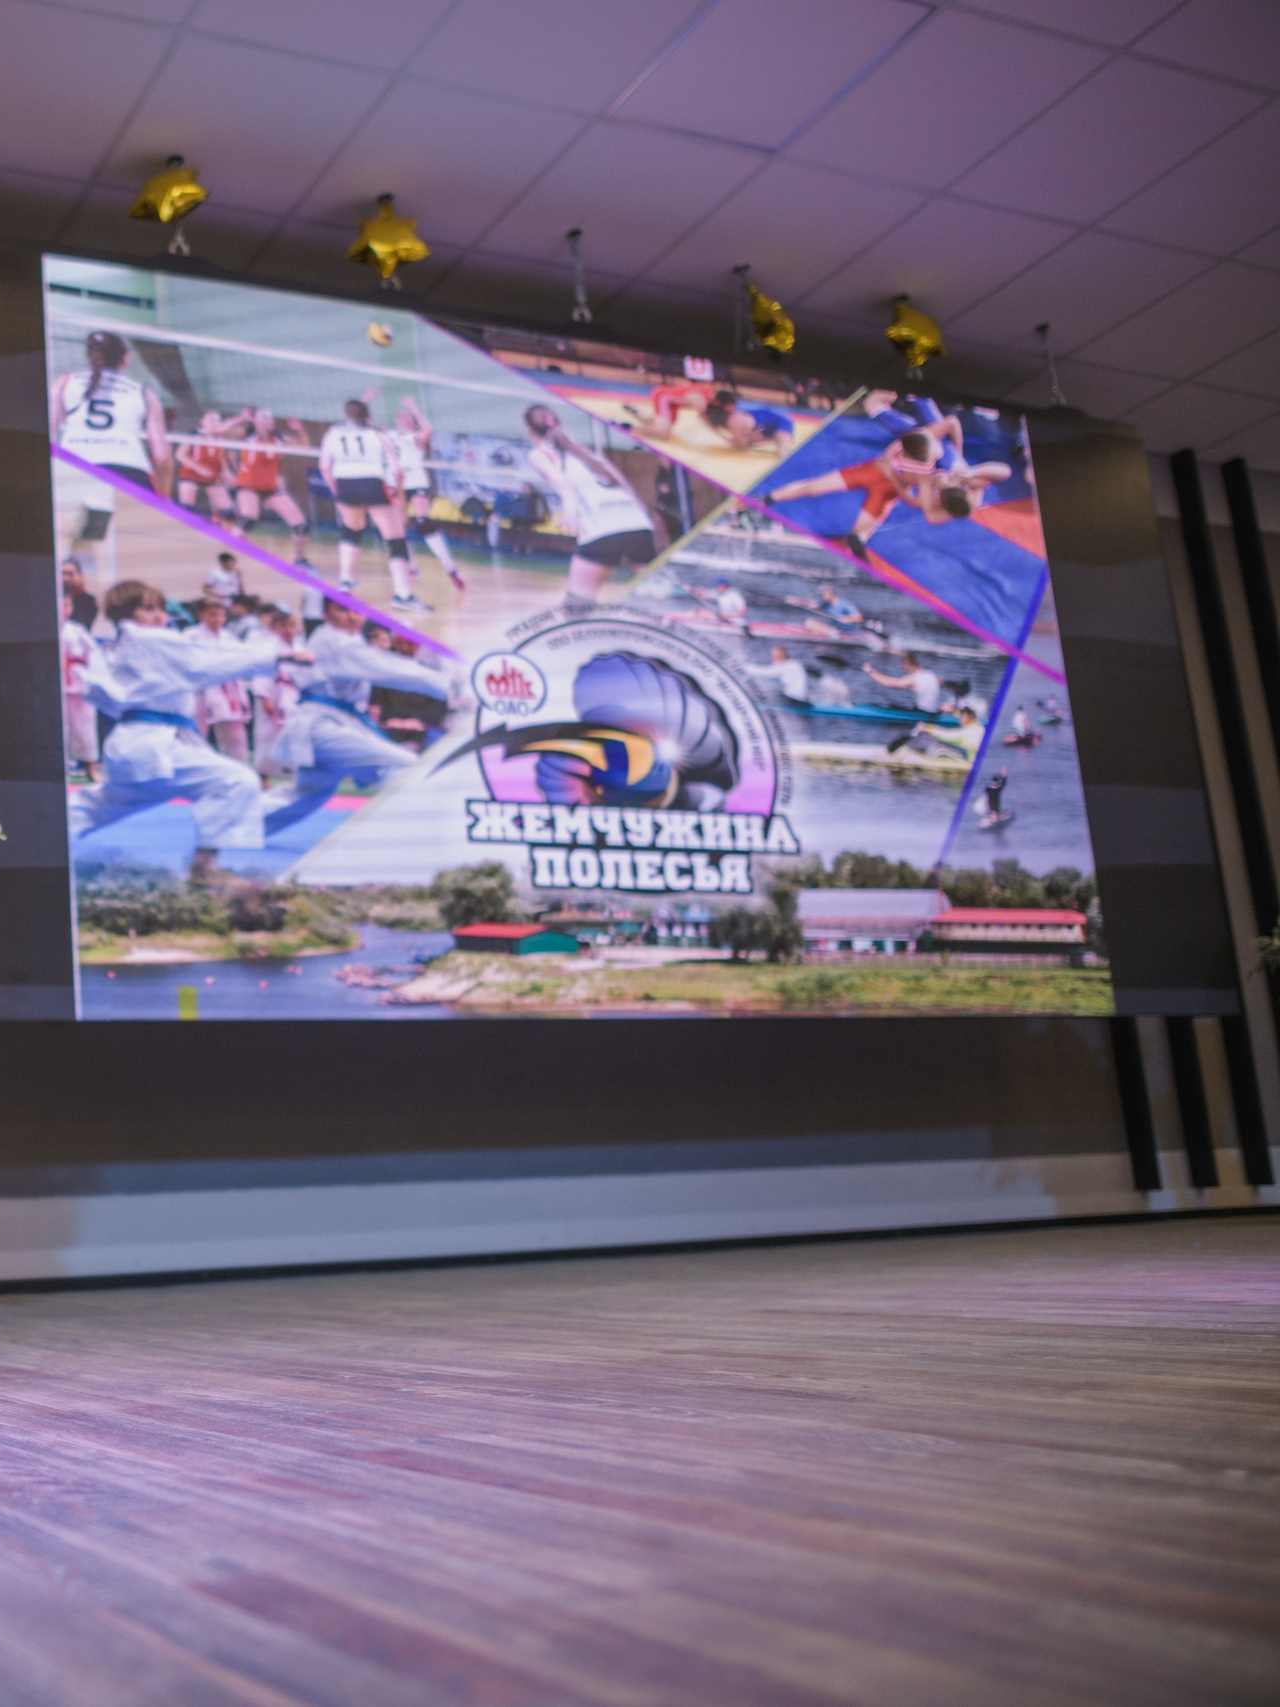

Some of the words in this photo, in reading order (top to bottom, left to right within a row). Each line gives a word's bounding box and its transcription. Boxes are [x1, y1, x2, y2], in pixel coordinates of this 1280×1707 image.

[84, 398, 115, 431] 5
[340, 435, 365, 457] 11
[494, 700, 529, 717] ОАО
[468, 800, 799, 852] ЖЕМЧУЖИНА
[532, 846, 752, 893] ПОЛЕСЬЯ
